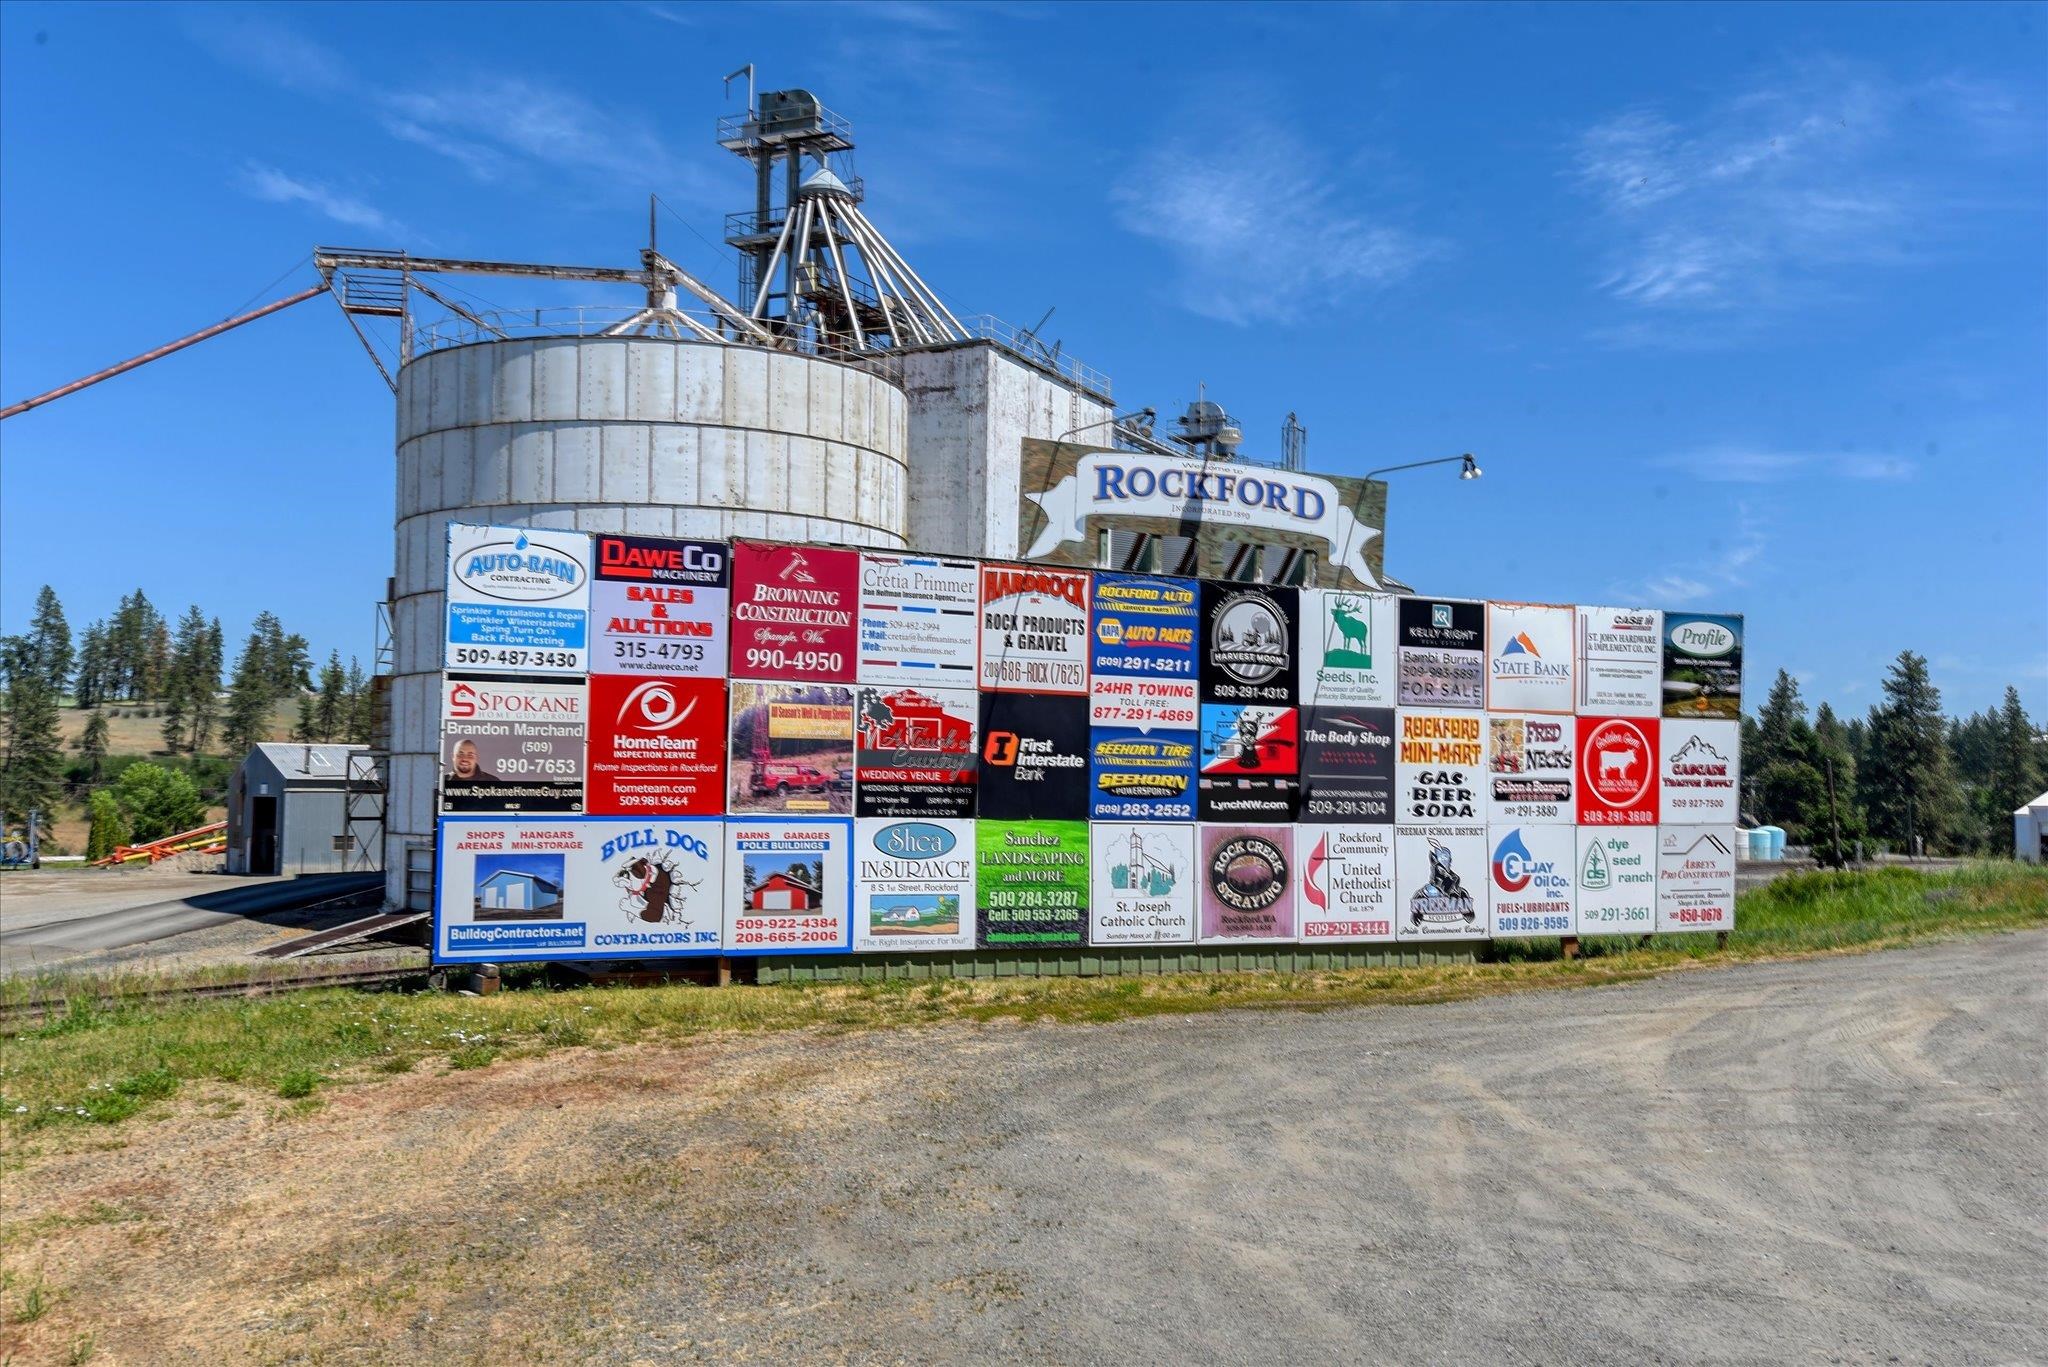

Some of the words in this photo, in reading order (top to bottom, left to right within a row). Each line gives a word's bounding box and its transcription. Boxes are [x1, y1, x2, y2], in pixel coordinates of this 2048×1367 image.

[1093, 464, 1326, 522] ROCKFORD
[1171, 504, 1232, 518] INCORPORATED
[464, 553, 576, 586] AUTO-RAIN
[652, 568, 720, 582] MACHINERY
[490, 574, 552, 585] CONTRACTING
[863, 568, 909, 590] Cretia
[914, 572, 975, 594] Primmer
[626, 586, 695, 605] SALES
[752, 583, 841, 606] BROWNING
[984, 570, 1087, 613] HARDROCK
[1097, 585, 1159, 601] ROCKFORD
[1161, 590, 1194, 604] AUTO
[451, 606, 492, 617] Sprinkler
[496, 608, 545, 618] Installation
[557, 610, 584, 622] Repair
[735, 602, 853, 626] CONSTRUCTION
[461, 616, 504, 628] Sprinkler
[507, 617, 576, 629] Winterizations
[481, 624, 510, 636] Spring
[513, 625, 534, 635] Turn
[536, 626, 556, 636] On's
[605, 617, 713, 638] AUCTIONS
[984, 612, 1019, 631] ROCK
[1022, 615, 1086, 636] PRODUCTS
[471, 633, 497, 643] Back
[500, 634, 525, 645] Flow
[527, 636, 565, 649] Testing
[1124, 625, 1157, 641] AUTO
[1158, 627, 1194, 644] PARTS
[1681, 627, 1727, 650] Profile
[1003, 634, 1014, 648] &
[1017, 633, 1068, 652] GRAVEL
[456, 649, 577, 668] 509-487-3430
[614, 641, 704, 661] 315-4793
[746, 648, 843, 672] 990-4950
[1096, 656, 1122, 668] (509)
[1123, 656, 1192, 673] 291-5211
[1214, 651, 1256, 666] HARVEST
[1256, 655, 1285, 668] MOON
[1403, 651, 1439, 665] Bambi
[1443, 653, 1479, 667] Burrus
[618, 661, 700, 673] www.daweco.net
[1492, 658, 1531, 675] STATE
[1534, 660, 1570, 677] BANK
[1316, 670, 1356, 685] Seeds,
[1358, 671, 1379, 685] Inc.
[1094, 682, 1133, 696] 24HR
[1137, 684, 1194, 698] TOWING
[1214, 684, 1289, 700] 509-291-4313
[1402, 681, 1434, 697] FOR
[1440, 683, 1481, 699] SALE
[478, 692, 580, 714] SPOKANE
[1119, 698, 1141, 707] TOLL
[1144, 700, 1170, 709] FREE:
[1093, 707, 1193, 722] 877-291-4869
[446, 720, 510, 736] Brandon
[513, 722, 584, 738] Marchand
[1403, 715, 1481, 742] ROCKFORD
[1525, 720, 1562, 744] FRED
[613, 735, 698, 751] HomeTeam
[1019, 737, 1054, 753] First
[1304, 729, 1327, 743] The
[1327, 730, 1359, 748] Body
[1359, 731, 1392, 748] Shop
[521, 742, 553, 756] (509)
[613, 751, 662, 759] INSPECTION
[663, 752, 697, 761] SERVICE
[1095, 741, 1158, 757] SEEHORN
[1162, 745, 1194, 758] TIRE
[1400, 741, 1482, 767] MINI-MART
[496, 757, 577, 774] 990-7653
[1016, 752, 1085, 768] Interstate
[860, 770, 907, 781] WEDDING
[910, 771, 942, 781] VENUE
[1014, 766, 1046, 781] Bank
[1671, 763, 1728, 777] CASCADE
[613, 783, 697, 794] hometeam.com
[1098, 773, 1189, 791] SEEHORN
[1662, 777, 1702, 788] TRACTOR
[1703, 778, 1735, 789] SUPPLY
[445, 786, 583, 800] www.SpokaneHomeGuy.com
[1115, 785, 1171, 797] POWERSPORTS
[1411, 787, 1472, 802] BEER
[619, 796, 689, 808] 509.981.9664
[1210, 799, 1289, 811] LynchNW.com
[1308, 800, 1387, 816] 509-291-3104
[1671, 799, 1687, 808] 509
[1689, 799, 1725, 808] 927-7500
[1095, 804, 1121, 816] (509)
[1121, 803, 1191, 818] 283-2552
[1411, 803, 1474, 818] SODA
[466, 831, 506, 841] SHOPS
[519, 831, 575, 841] HANGARS
[736, 832, 771, 840] BARNS
[783, 832, 831, 840] GARAGES
[1003, 830, 1061, 847] Sanchez
[1338, 832, 1383, 844] Rockford
[1396, 826, 1427, 837] FREEMAN
[1428, 826, 1455, 837] SCHOOL
[1455, 826, 1485, 837] DISTRICT
[456, 842, 504, 851] ARENAS
[511, 841, 584, 851] MINI-STORAGE
[600, 828, 659, 862] BULL
[664, 829, 710, 861] DOG
[742, 841, 770, 850] POLE
[771, 840, 826, 850] BUILDINGS
[1332, 843, 1390, 857] Community
[1607, 838, 1630, 853] dye
[981, 851, 1086, 867] LANDSCAPING
[1214, 840, 1247, 875] ROCK
[1246, 839, 1286, 875] CREEK
[1612, 853, 1642, 867] seed
[860, 860, 970, 879] INSURANCE
[1002, 868, 1023, 883] and
[1025, 870, 1065, 883] MORE
[1341, 862, 1383, 876] United
[1618, 870, 1654, 883] ranch
[1660, 869, 1677, 880] PRO
[1677, 868, 1731, 881] CONSTRUCTION
[1332, 876, 1393, 891] Methodist
[989, 891, 1016, 908] 509
[1018, 891, 1079, 908] 284-3287
[1216, 880, 1284, 909] SPRAYING
[1339, 890, 1384, 904] Church
[1115, 901, 1130, 913] St.
[1132, 900, 1172, 915] Joseph
[1496, 902, 1520, 914] FUELS
[1523, 901, 1570, 914] LUBRICANTS
[1584, 909, 1600, 920] 509
[1600, 907, 1650, 922] 291-3661
[735, 918, 840, 931] 509-922-4384
[1100, 915, 1146, 928] Catholic
[1147, 914, 1186, 927] Church
[1306, 921, 1388, 936] 509-291-3444
[1498, 917, 1519, 931] 509
[1520, 916, 1569, 931] 926-9595
[450, 925, 584, 942] BulldogContractors.net
[593, 932, 691, 947] CONTRACTORS
[693, 931, 720, 943] INC.
[735, 931, 840, 944] 208-665-2006
[879, 938, 899, 949] Right
[900, 938, 936, 948] Insurance
[937, 937, 951, 947] For
